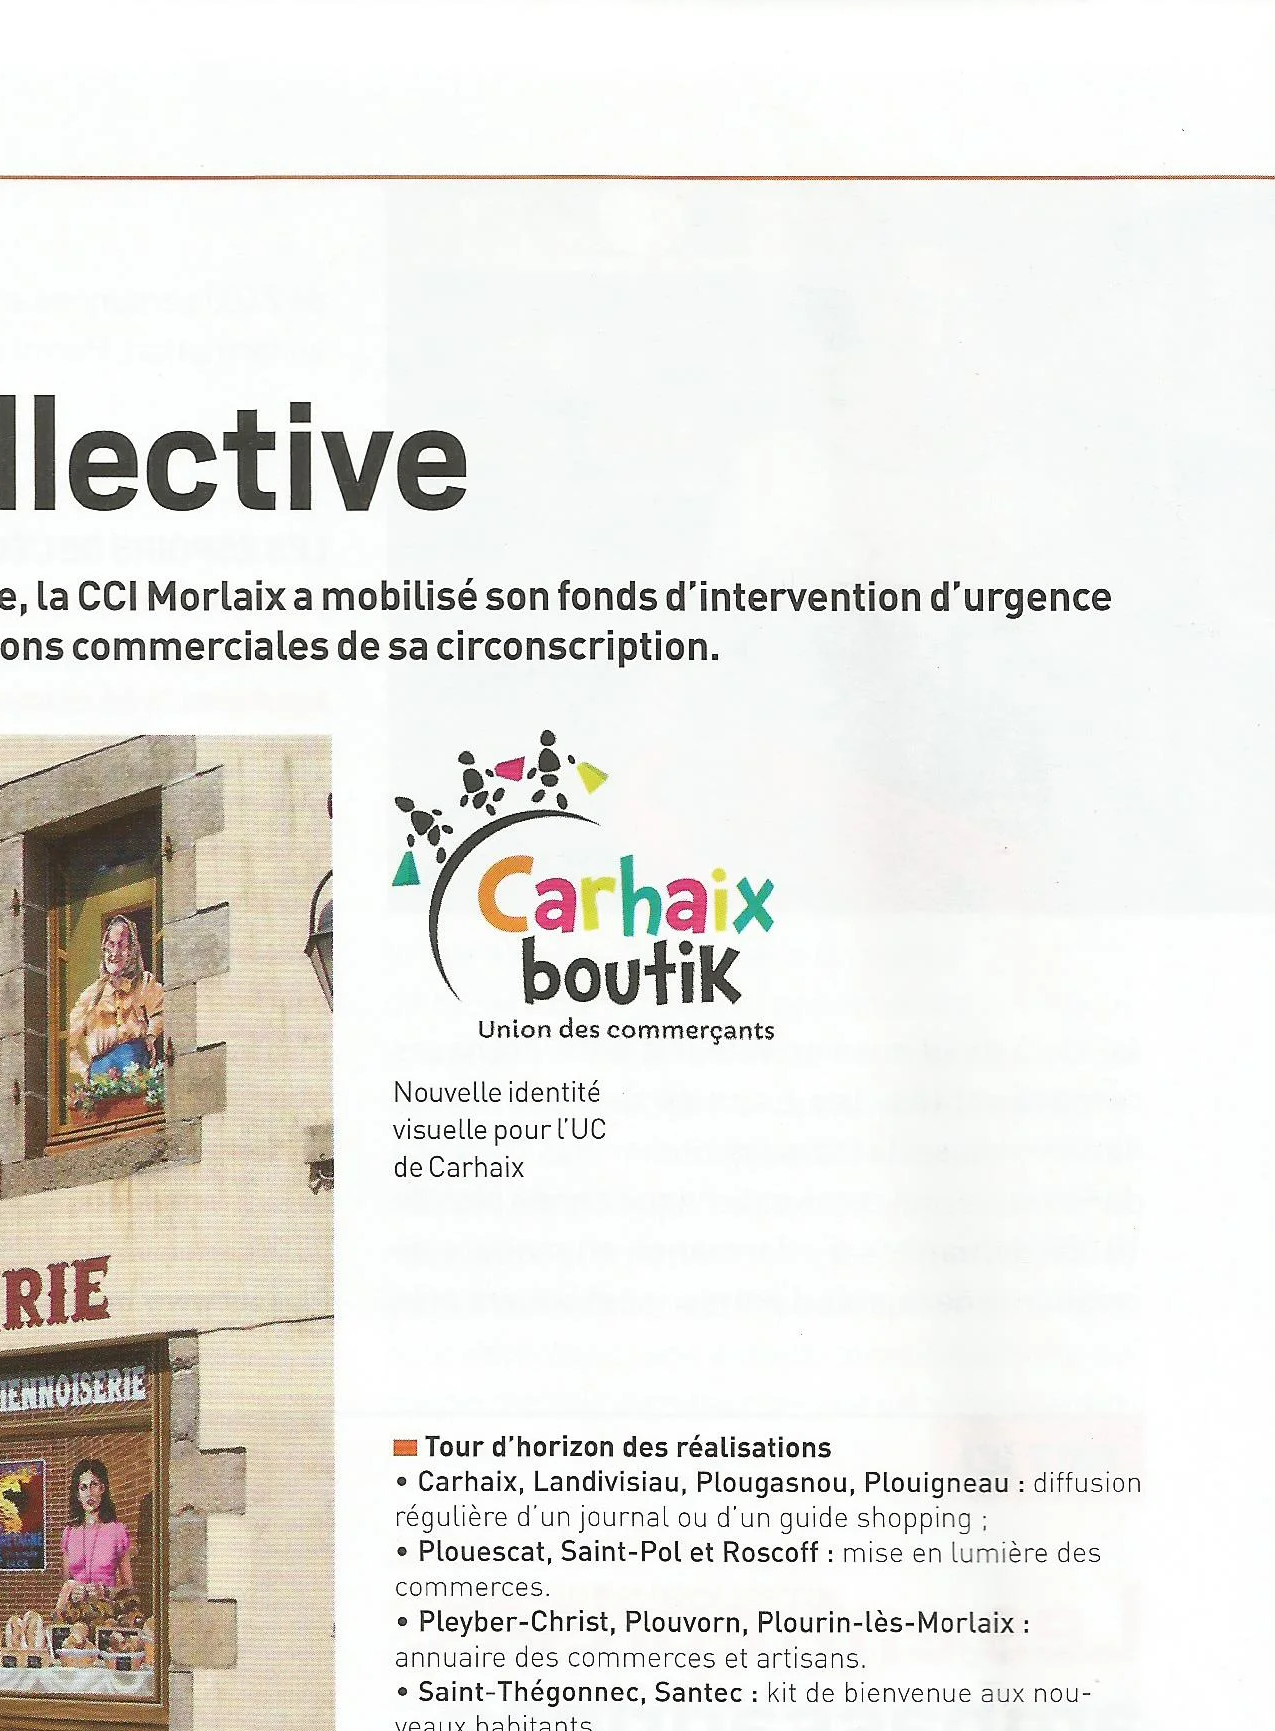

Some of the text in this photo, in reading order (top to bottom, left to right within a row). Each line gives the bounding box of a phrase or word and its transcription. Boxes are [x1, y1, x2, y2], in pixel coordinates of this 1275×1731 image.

[37, 579, 69, 611] la
[78, 579, 137, 612] CCI
[147, 579, 287, 612] Morlaix
[293, 587, 313, 611] a
[322, 577, 478, 611] mobilisé
[485, 587, 550, 611] son
[557, 579, 658, 612] fonds
[665, 580, 922, 612] d'intervention
[930, 580, 1112, 620] d'urgence
[72, 629, 329, 661] commerciales
[337, 629, 380, 661] de
[387, 637, 428, 661] sa
[436, 629, 719, 669] circonscription.
[478, 855, 774, 936] Carhaix
[478, 1016, 775, 1046] Union des commerçants
[394, 1079, 601, 1103] Nouvelle identité
[392, 1117, 606, 1146] visuelle pour l'UC
[394, 1155, 525, 1178] de Carhaix
[424, 1433, 832, 1459] Tour d'horizon des réalisations
[418, 1469, 1141, 1500] Carhaix, Landivisiau, Plougasnou, Plouigneau : diffusion
